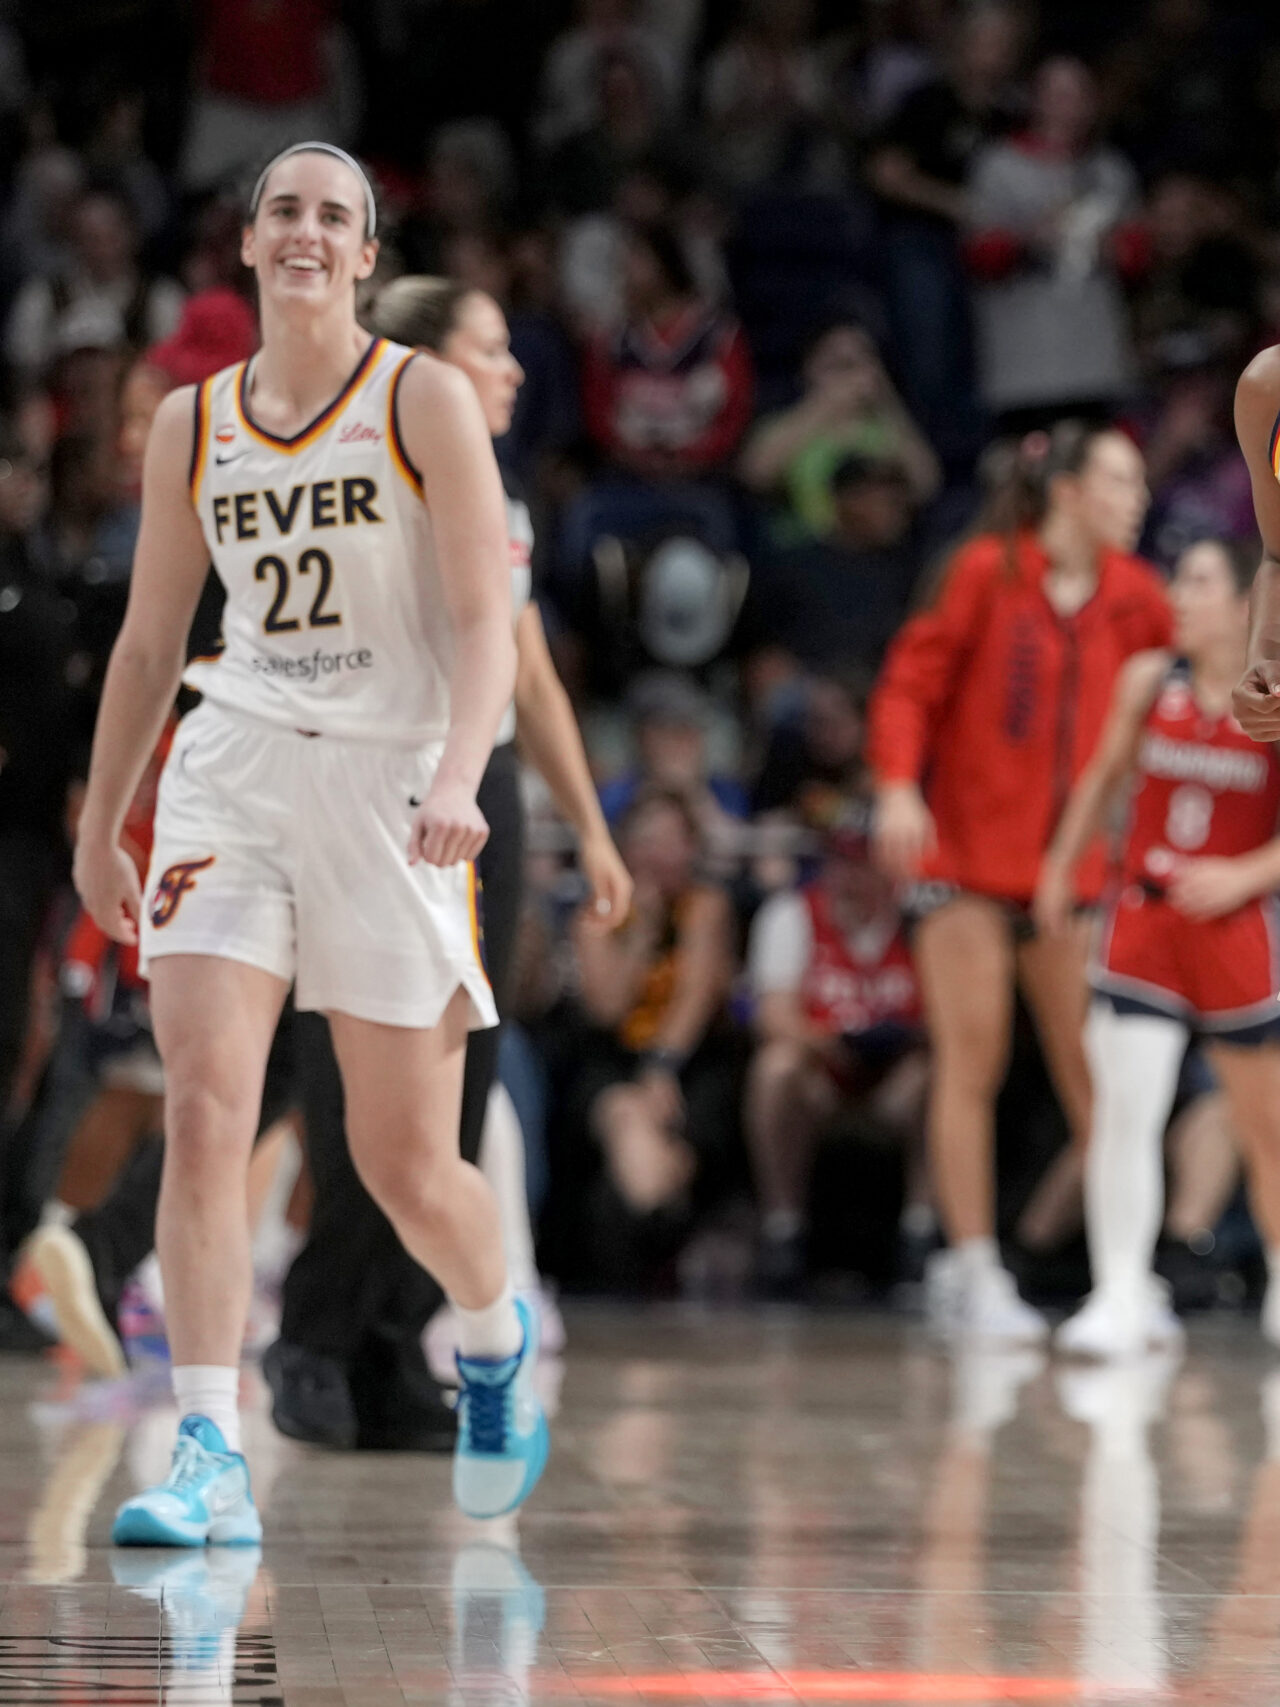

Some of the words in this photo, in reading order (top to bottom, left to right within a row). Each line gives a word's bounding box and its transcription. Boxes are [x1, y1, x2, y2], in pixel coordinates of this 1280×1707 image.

[212, 474, 385, 546] FEVER
[253, 547, 343, 635] 22
[252, 648, 374, 683] salesforce
